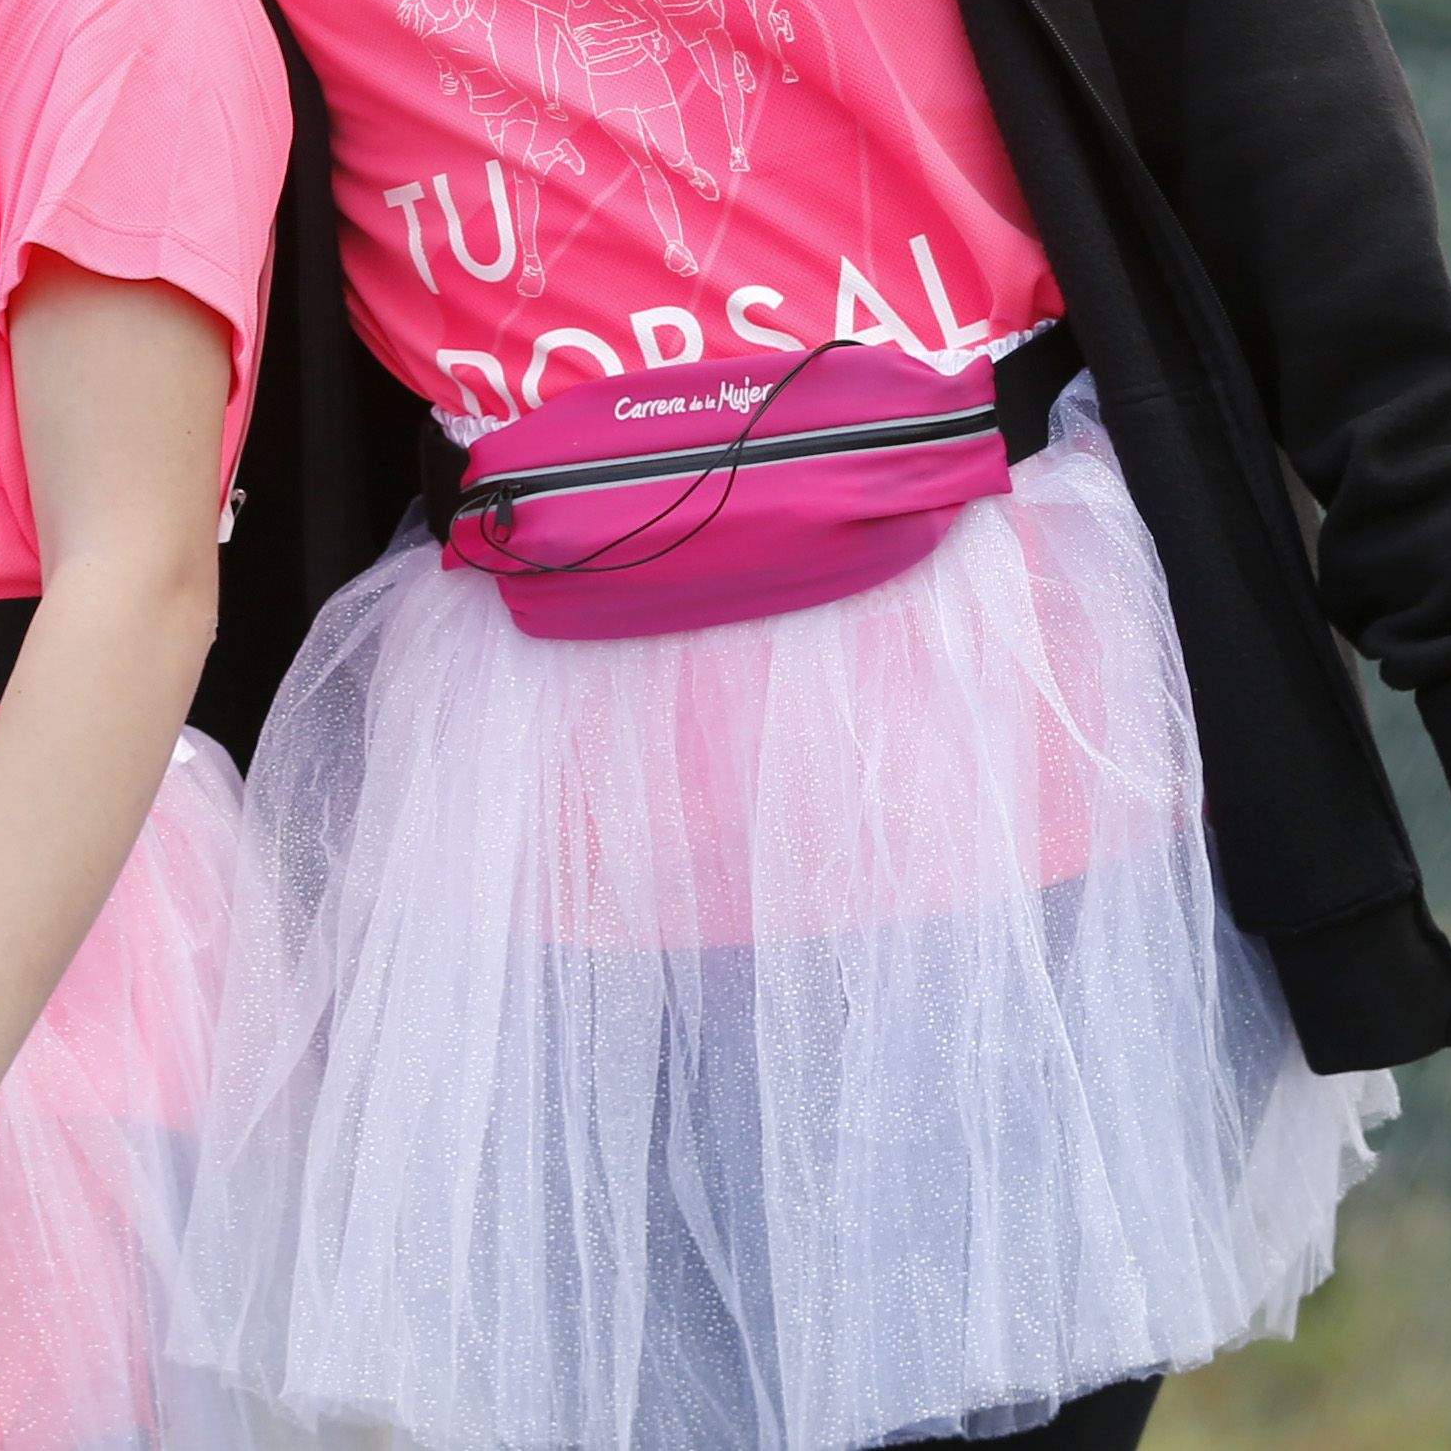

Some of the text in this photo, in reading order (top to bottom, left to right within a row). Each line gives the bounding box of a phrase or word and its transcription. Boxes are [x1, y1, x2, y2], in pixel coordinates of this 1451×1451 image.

[384, 159, 517, 295] TU
[435, 234, 990, 421] DORSAL
[614, 376, 774, 421] Carrera de la Mujer
